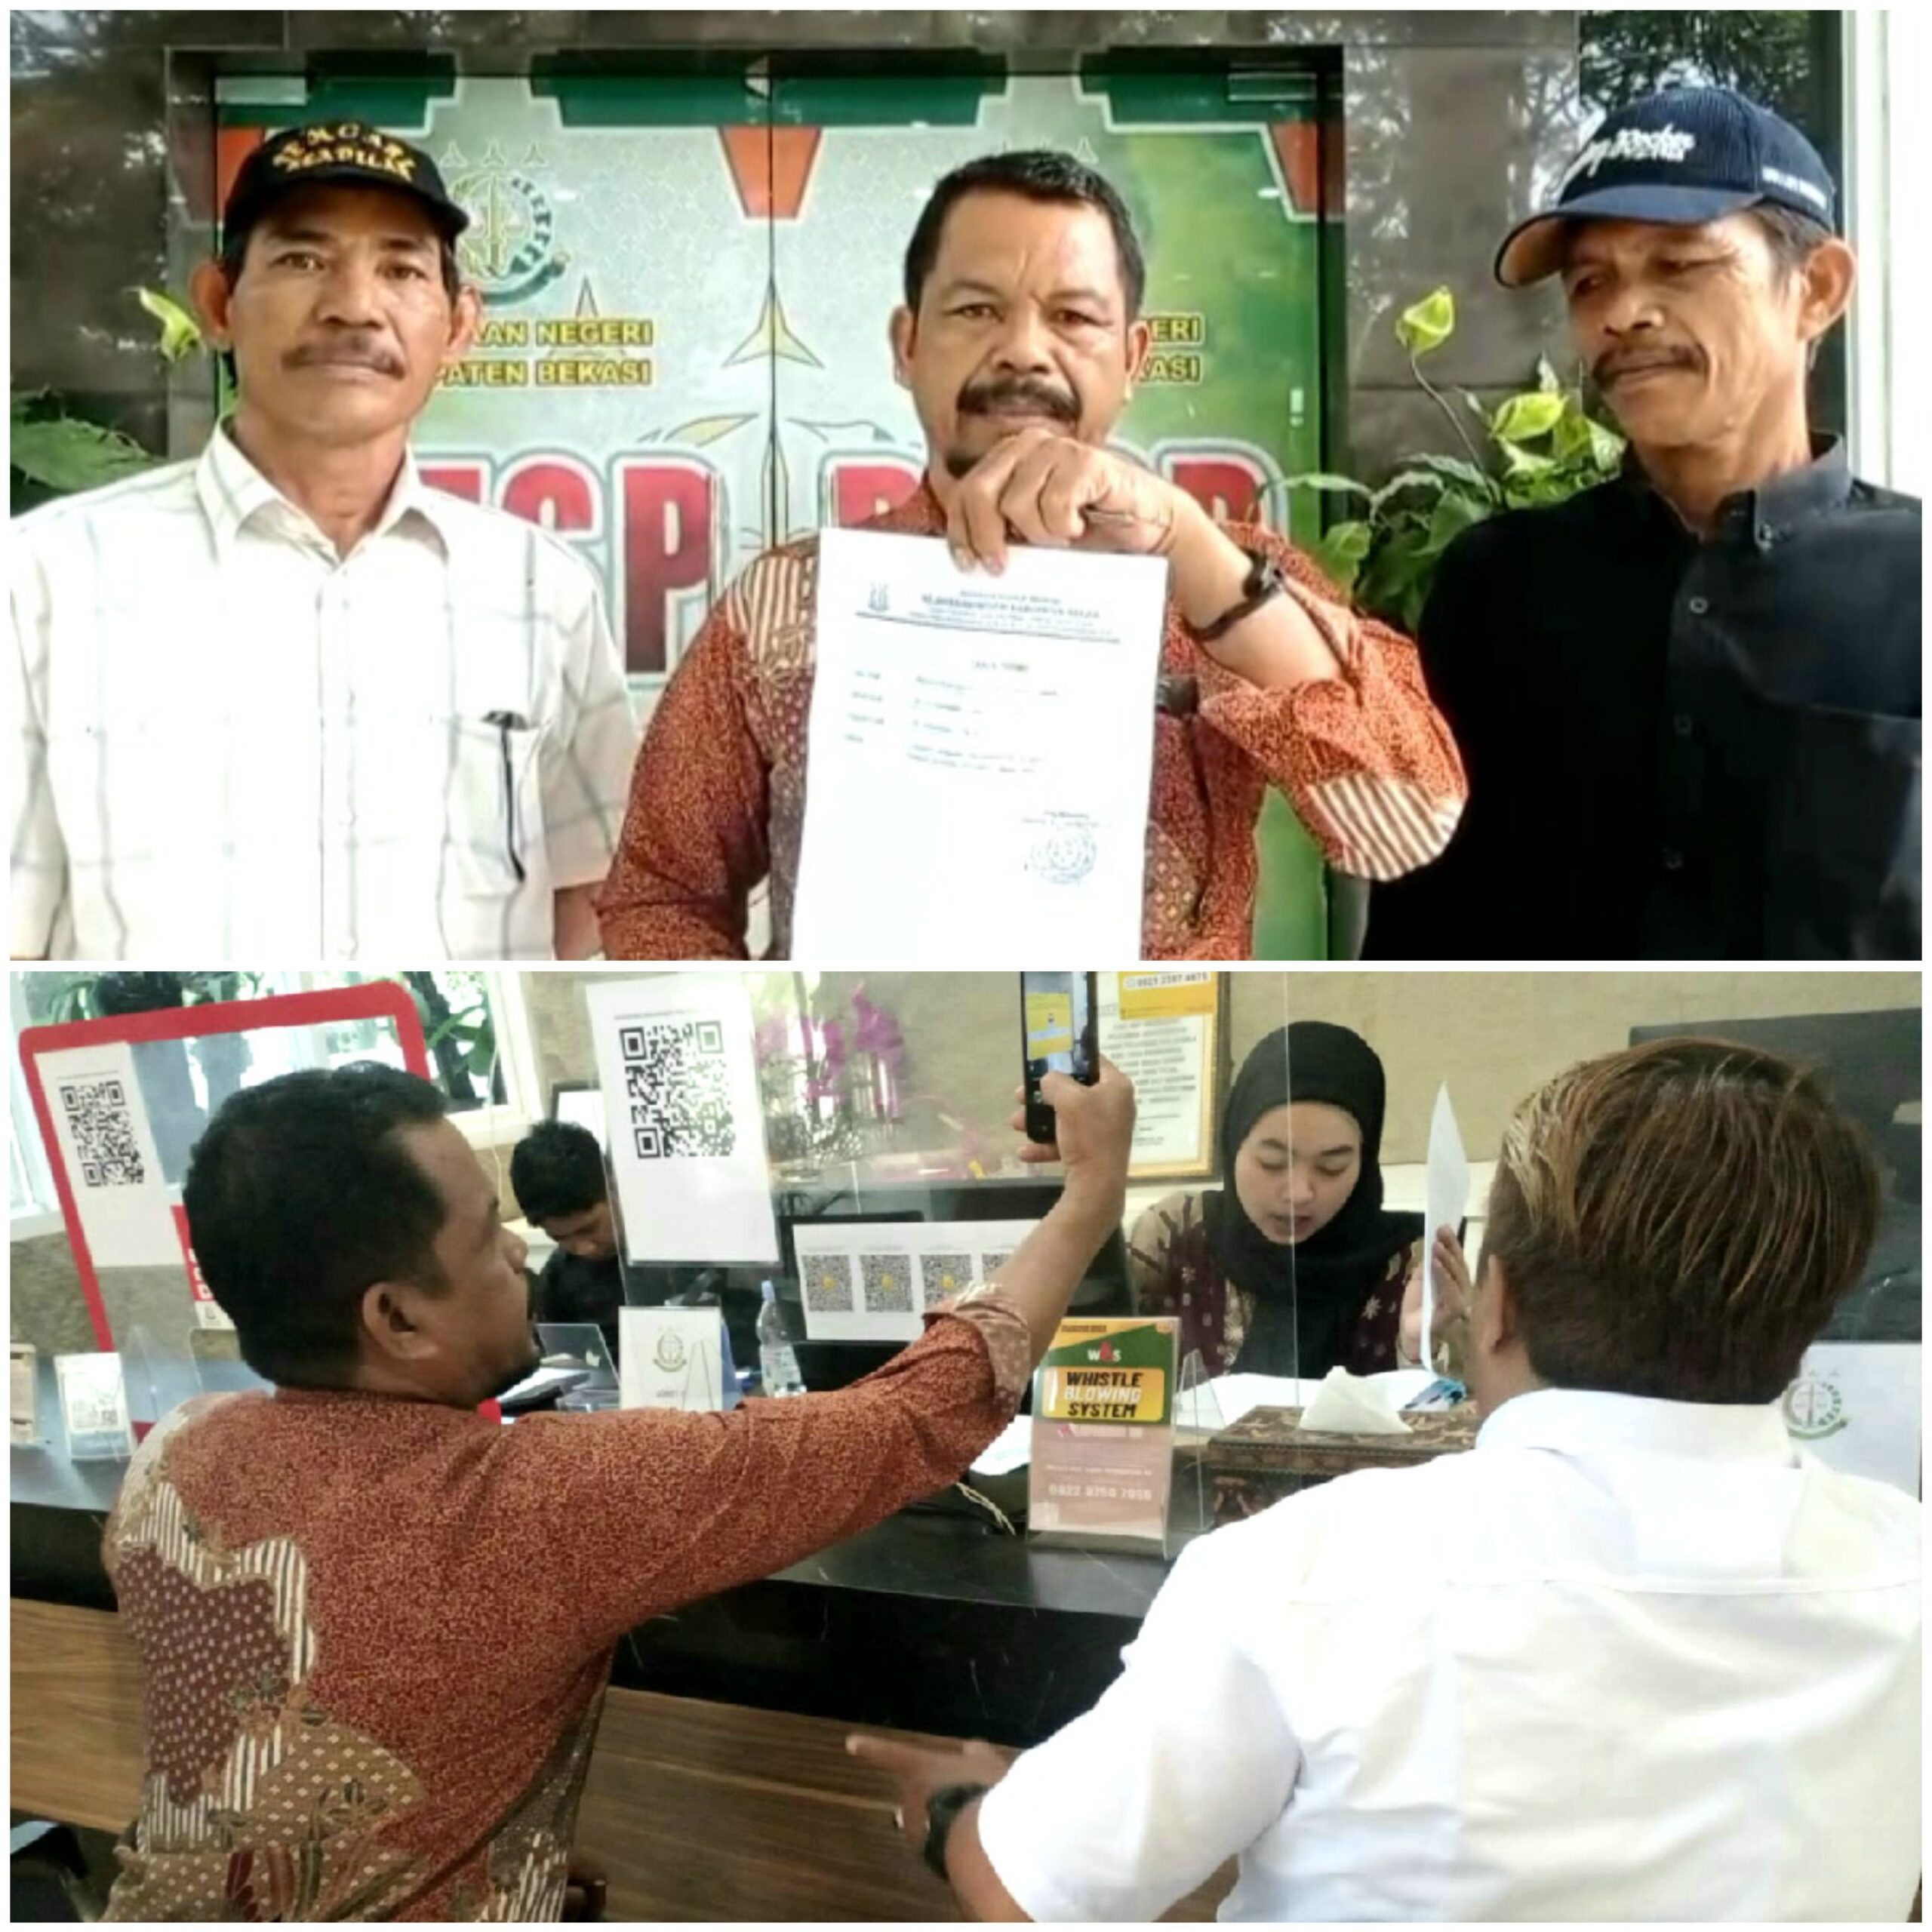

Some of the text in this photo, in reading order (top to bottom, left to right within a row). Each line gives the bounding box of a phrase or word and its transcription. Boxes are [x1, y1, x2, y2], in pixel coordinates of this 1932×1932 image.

[536, 321, 653, 346] NEGERI
[442, 361, 651, 385] ATEN BEKASI
[1066, 1371, 1145, 1387] WHISTLE
[1064, 1386, 1143, 1404] BLOWING
[1066, 1403, 1137, 1418] SYSTEM
